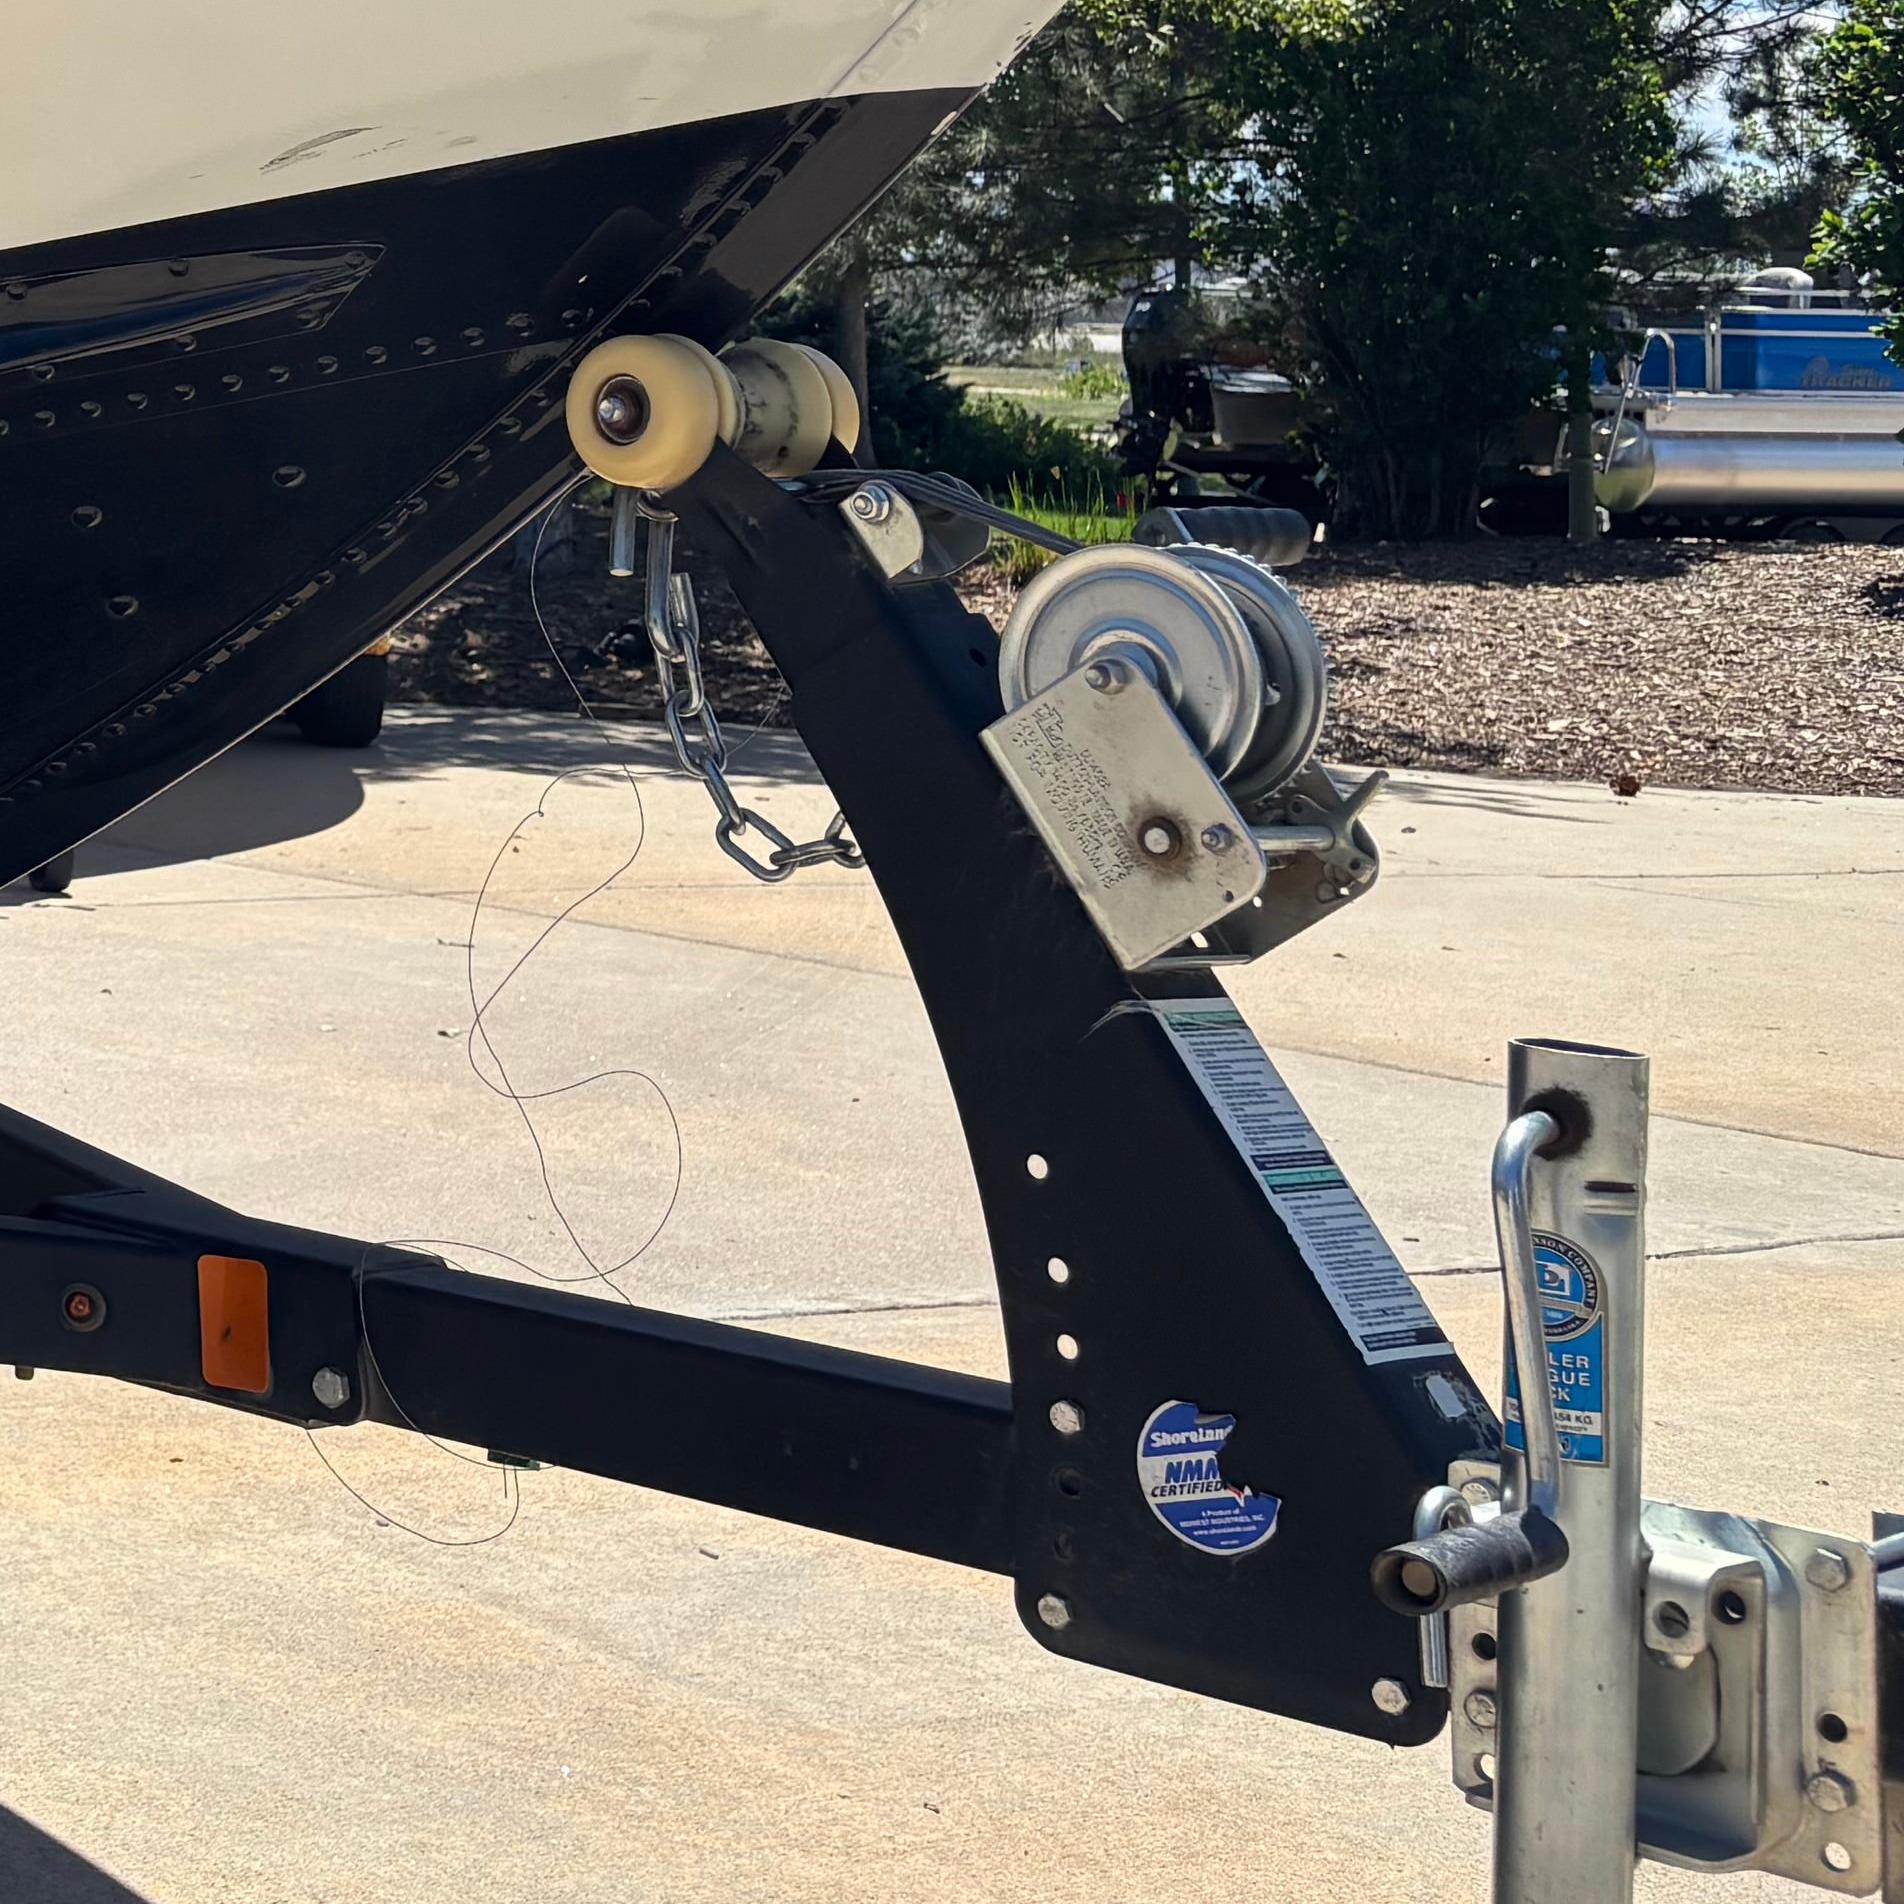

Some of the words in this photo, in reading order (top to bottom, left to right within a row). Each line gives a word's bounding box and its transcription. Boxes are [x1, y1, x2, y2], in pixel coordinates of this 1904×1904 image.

[1548, 1351, 1590, 1369] LER
[1548, 1368, 1591, 1387] GUE
[1151, 1481, 1224, 1497] CERTIFIED
